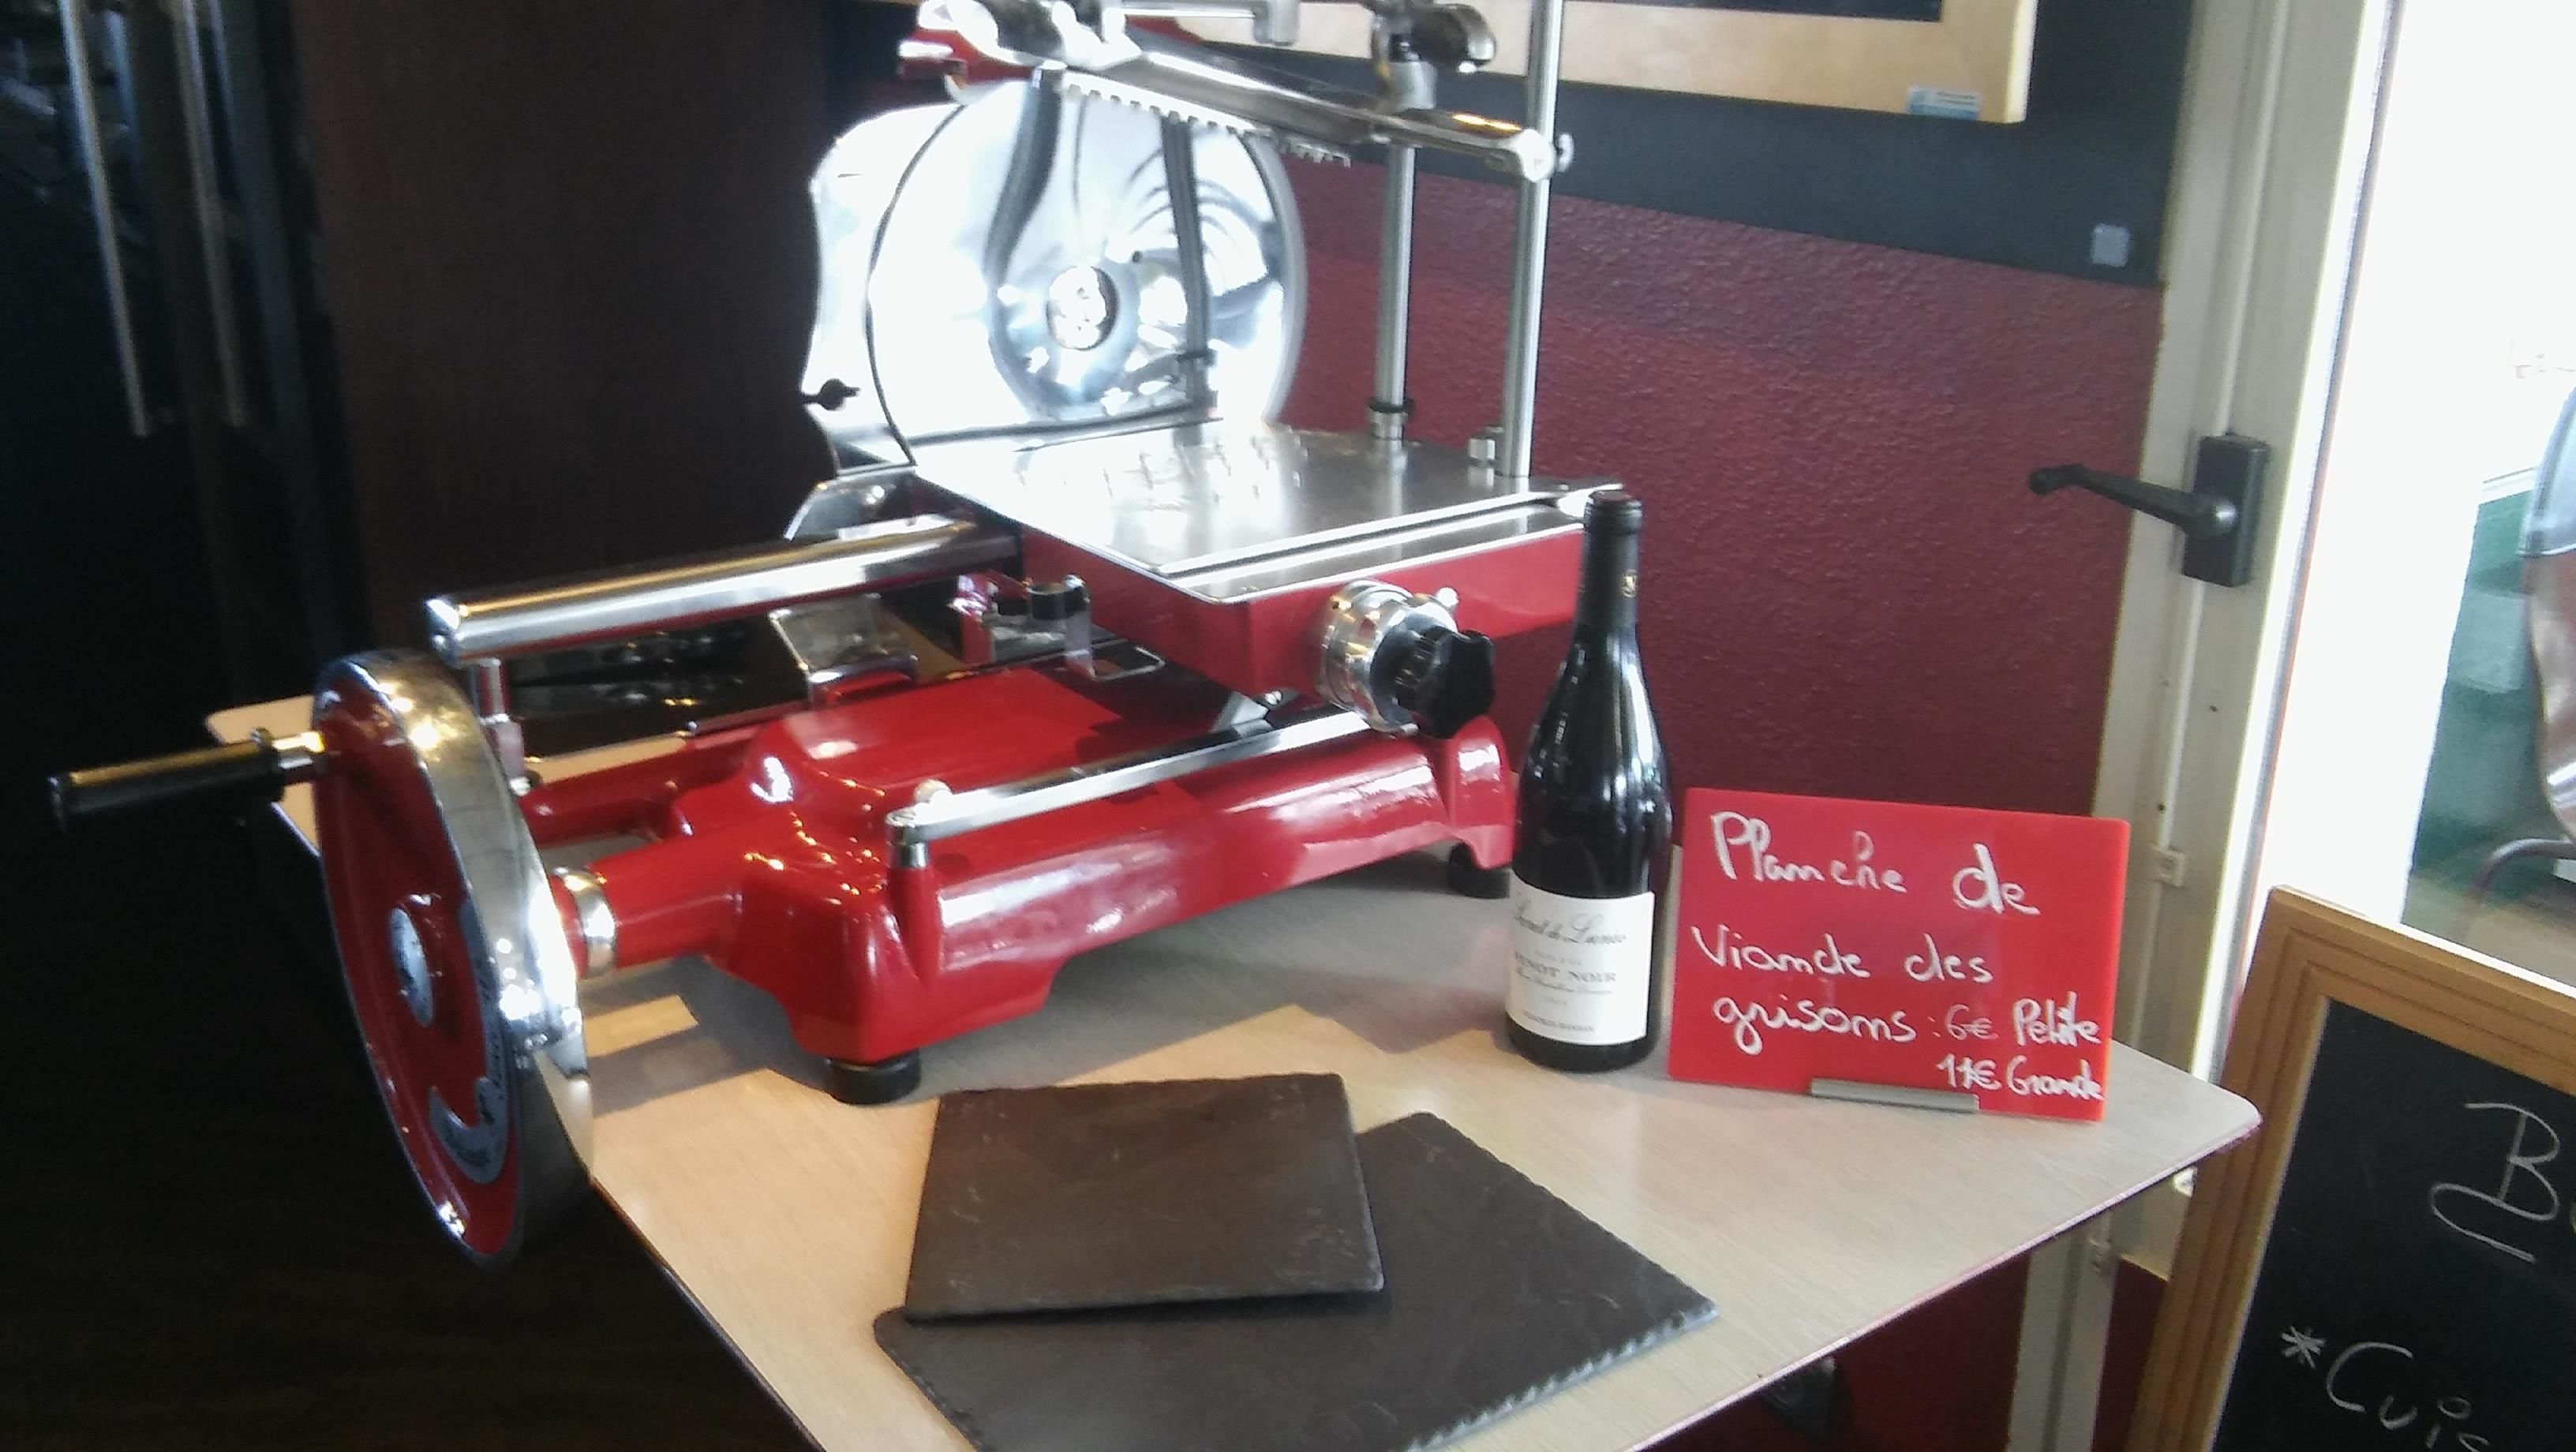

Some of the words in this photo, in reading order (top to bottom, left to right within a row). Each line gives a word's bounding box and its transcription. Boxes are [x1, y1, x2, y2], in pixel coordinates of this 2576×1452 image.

[1710, 810, 1907, 893] Planche
[1952, 842, 2041, 915] de
[1690, 923, 1870, 979] Viande
[1904, 933, 1994, 983] des
[2012, 990, 2102, 1047] Petite
[2005, 1054, 2105, 1102] Grande
